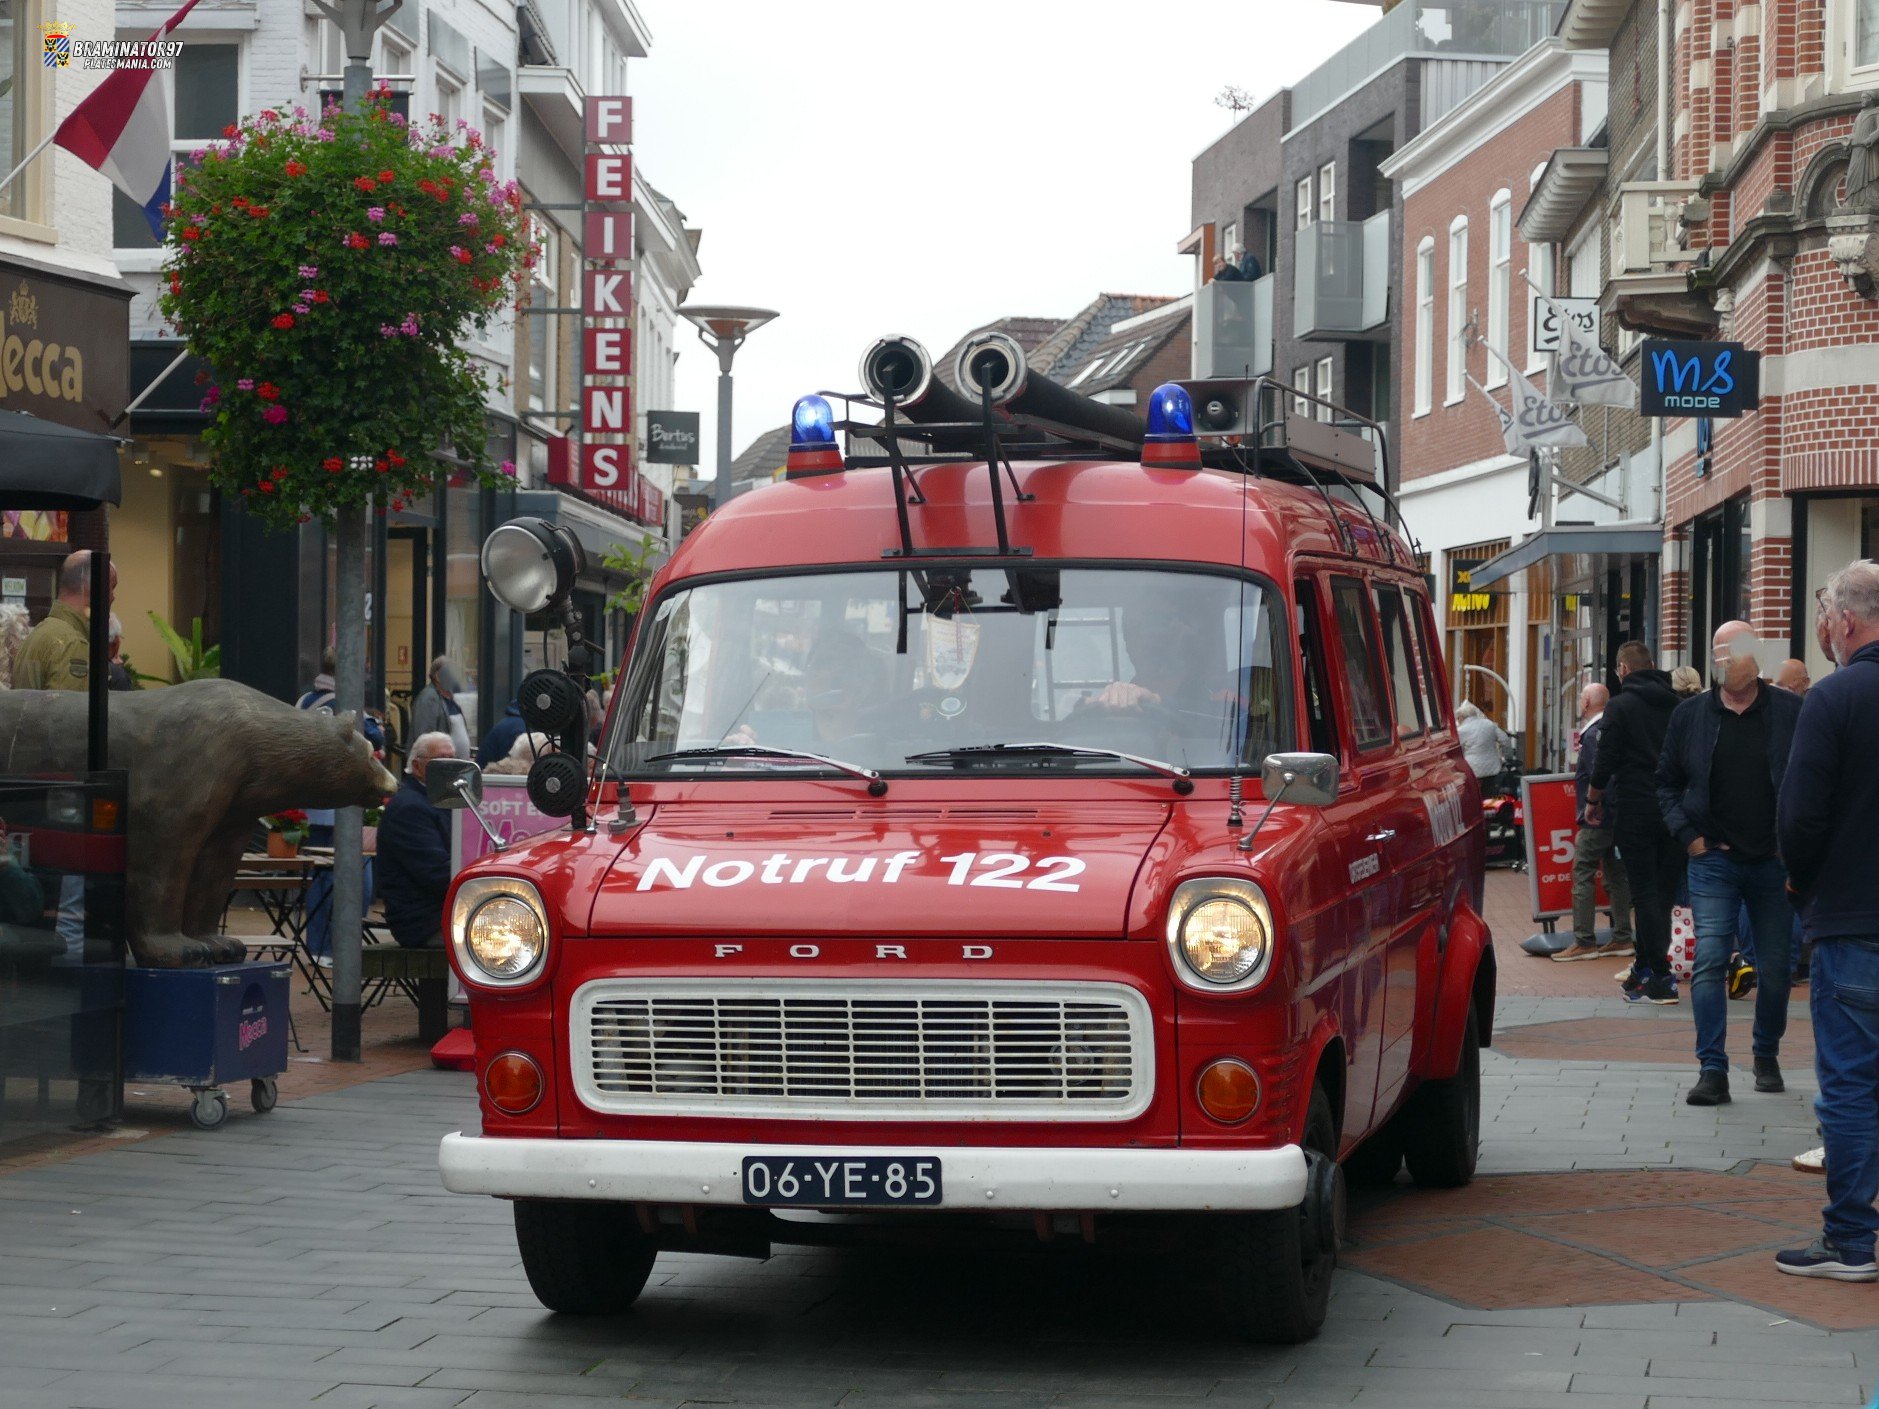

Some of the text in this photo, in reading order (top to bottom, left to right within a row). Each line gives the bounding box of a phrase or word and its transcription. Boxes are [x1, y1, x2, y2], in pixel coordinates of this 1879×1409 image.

[591, 100, 623, 487] FEIKENS
[1543, 306, 1595, 332] Eos
[1519, 396, 1573, 427] Eto
[480, 801, 523, 816] SOFT
[1539, 829, 1576, 864] -5
[636, 850, 1087, 893] Notruf 122
[1542, 874, 1556, 883] OP
[714, 944, 994, 960] FORD
